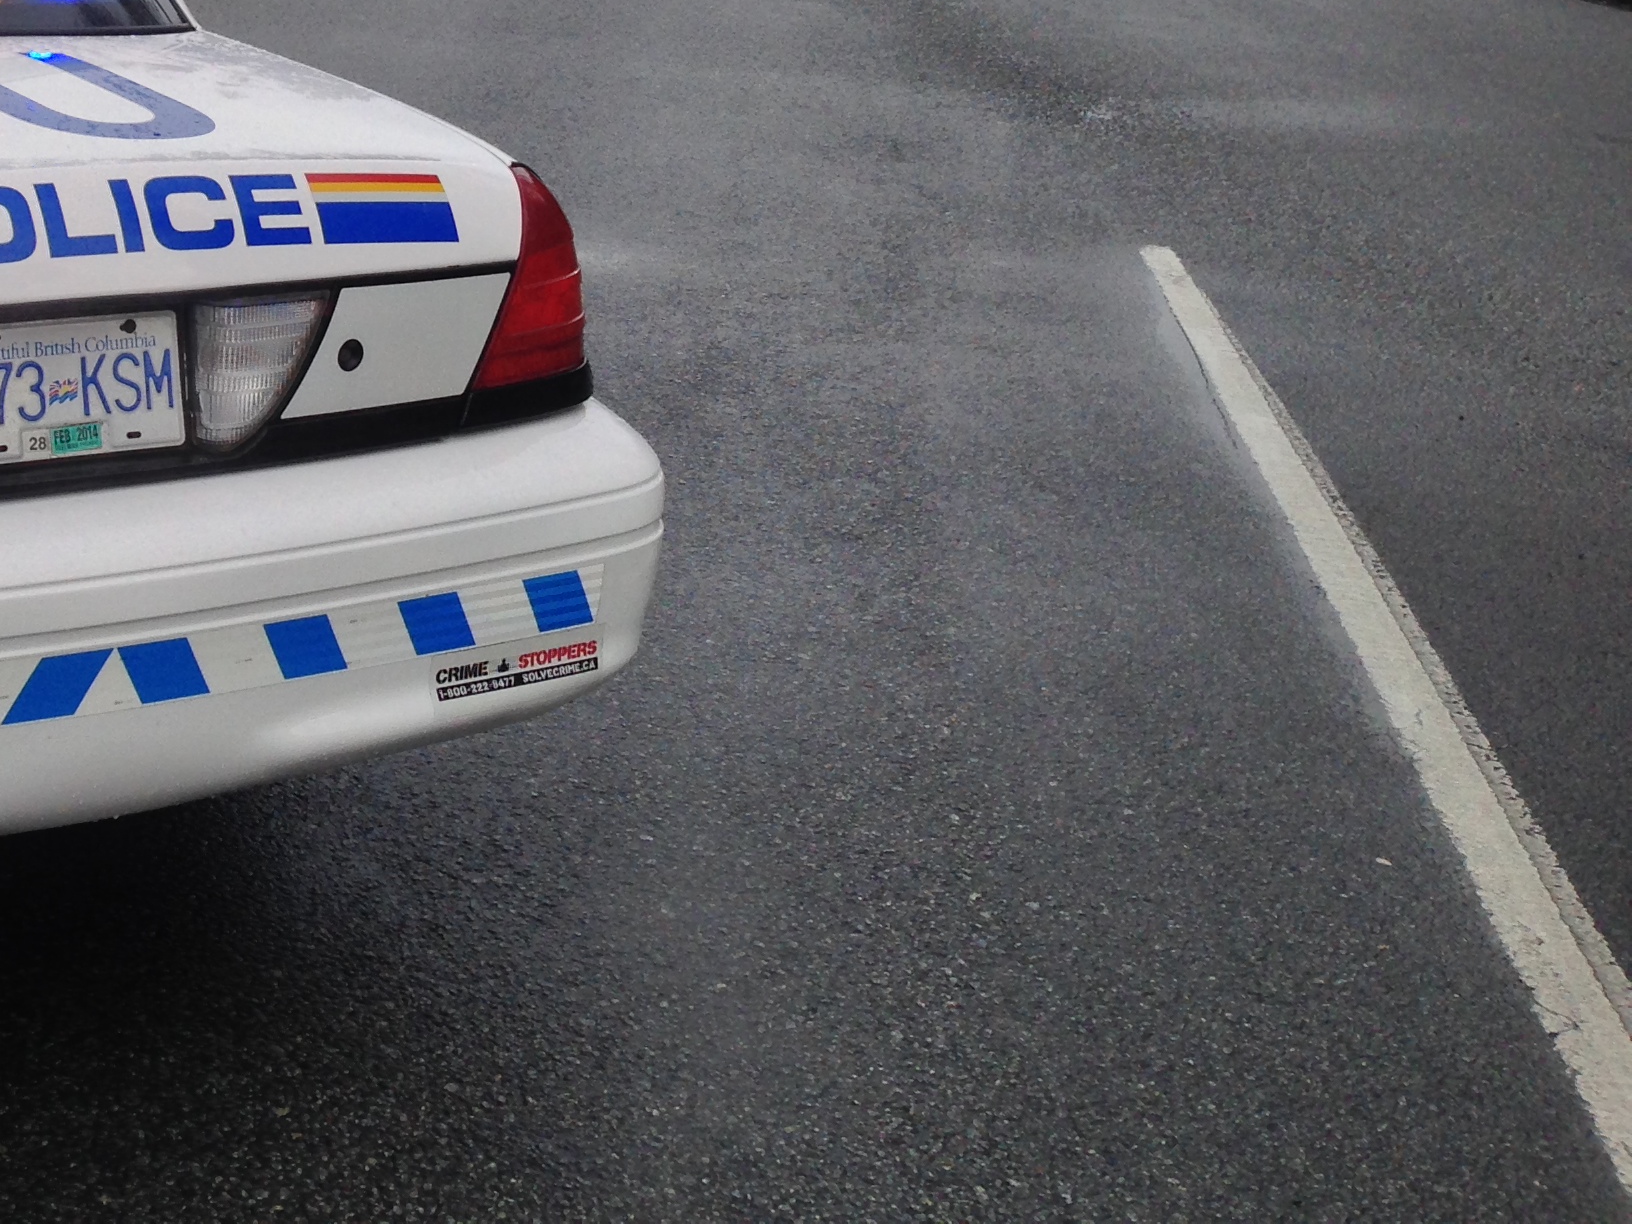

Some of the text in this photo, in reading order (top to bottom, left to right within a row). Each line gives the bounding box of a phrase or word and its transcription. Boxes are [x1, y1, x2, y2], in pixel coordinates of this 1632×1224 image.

[34, 336, 81, 358] British
[84, 332, 156, 352] Columbia
[80, 348, 174, 417] KSM
[29, 437, 47, 451] 28
[53, 424, 99, 445] FEB 2014
[435, 640, 598, 685] CRIME STOPPERS
[521, 660, 597, 684] SOLVECRIME.CA
